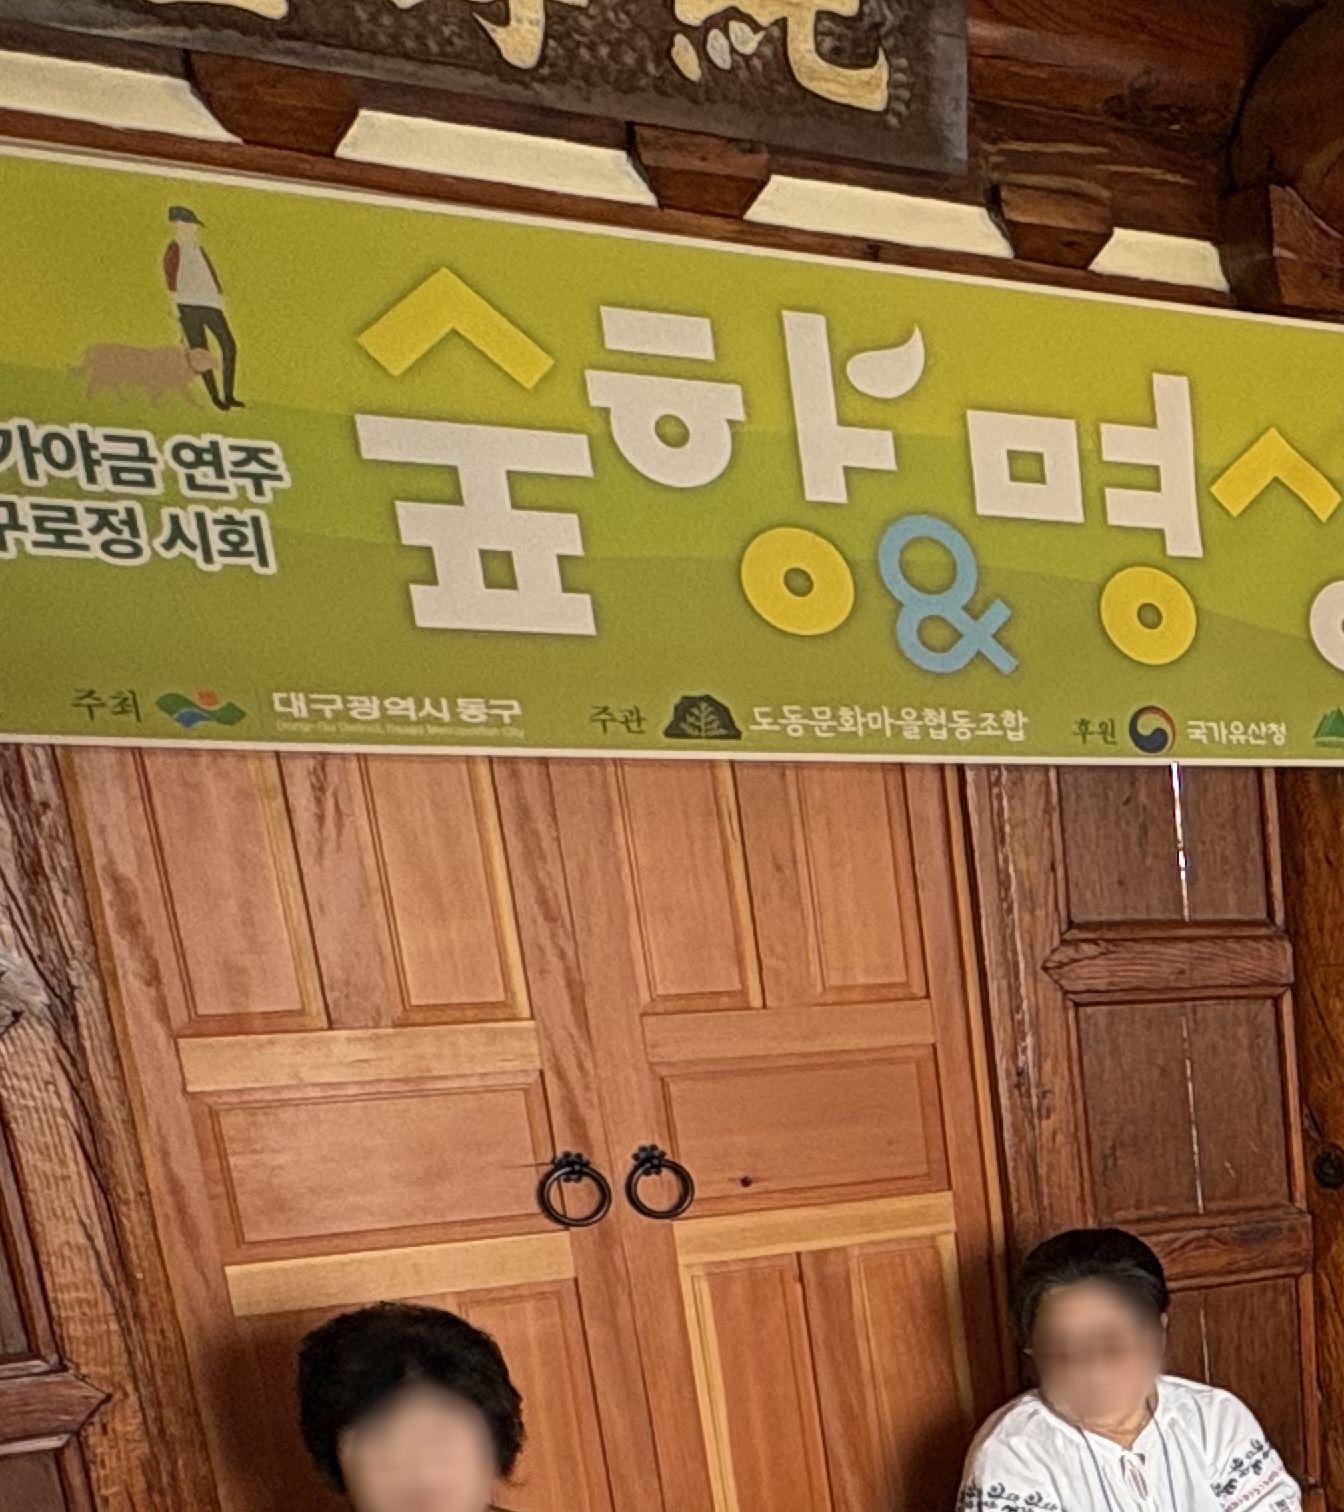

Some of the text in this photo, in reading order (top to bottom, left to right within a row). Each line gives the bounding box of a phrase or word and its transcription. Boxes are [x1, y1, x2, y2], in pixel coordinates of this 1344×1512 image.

[170, 439, 285, 497] 연주
[159, 511, 270, 569] 시회
[72, 688, 142, 723] 주최
[272, 690, 523, 724] 대구광역시 동구
[589, 705, 647, 735] 주관
[749, 704, 1029, 742] 도동문화마을협동조합
[1072, 717, 1117, 746] 후원
[1186, 720, 1287, 745] 국가유산청
